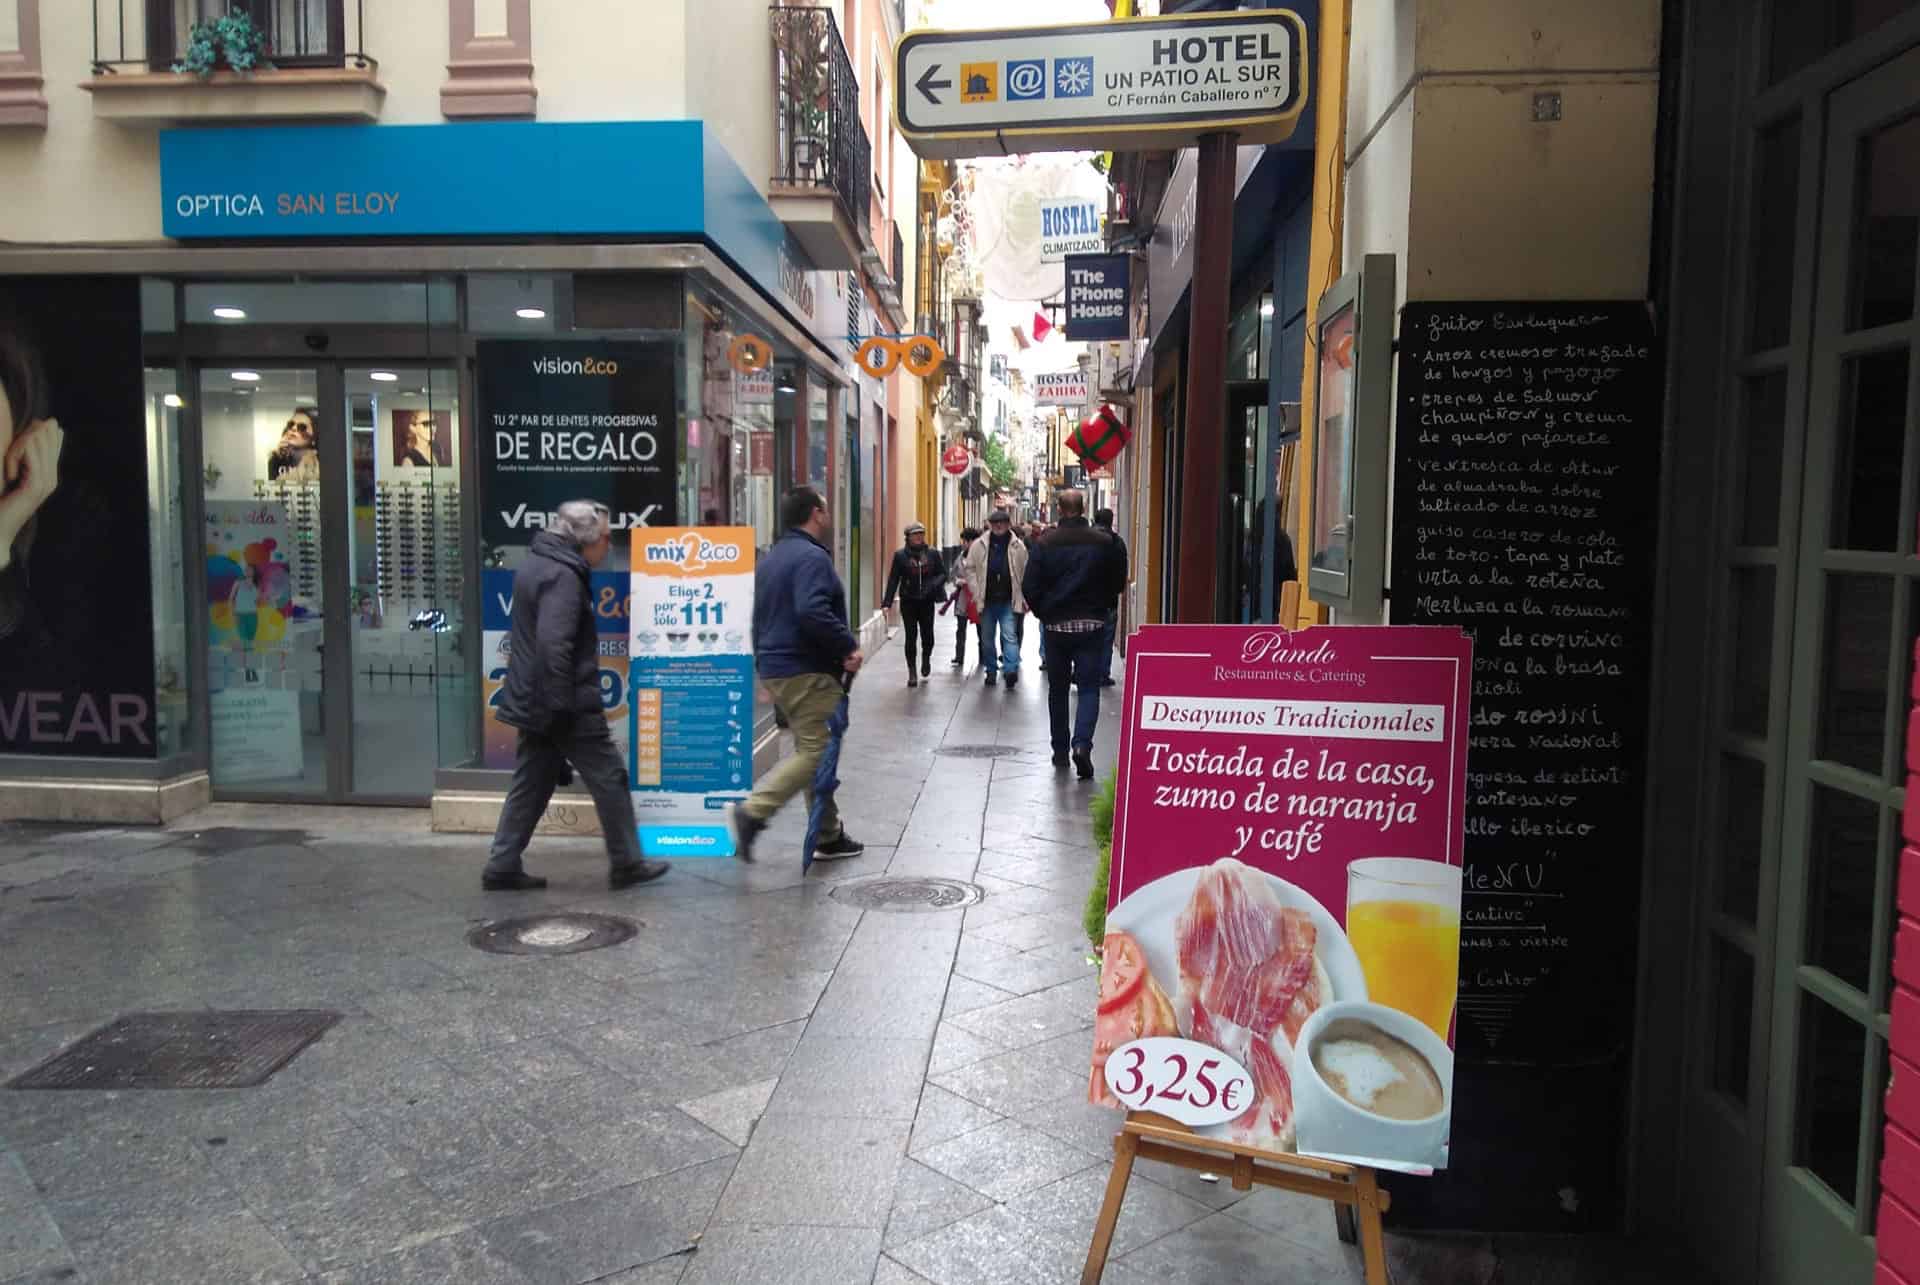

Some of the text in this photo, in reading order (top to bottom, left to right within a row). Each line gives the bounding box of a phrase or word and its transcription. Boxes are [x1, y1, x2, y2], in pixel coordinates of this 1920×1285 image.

[1153, 33, 1281, 65] HOTEL
[1105, 64, 1281, 89] UN PATIO AL SUR
[1107, 93, 1123, 107] C/
[1127, 90, 1176, 106] Fernán
[1181, 88, 1250, 104] Caballero
[1273, 86, 1281, 97] 7
[176, 192, 400, 217] OPTICA SAN ELOY
[1042, 204, 1098, 236] HOSTAL
[1042, 240, 1099, 254] CLIMATIZADO
[1071, 270, 1105, 284] The
[1071, 287, 1124, 301] Phone
[1071, 304, 1124, 318] House
[533, 357, 617, 374] vision&co
[1037, 373, 1087, 385] HOSTAL
[1423, 367, 1441, 380] de
[1521, 367, 1534, 383] y
[1494, 390, 1515, 403] de
[494, 415, 505, 426] TU
[521, 415, 539, 426] PAR
[542, 415, 554, 426] DE
[556, 415, 589, 426] LENTES
[592, 415, 657, 426] PROGRESIVAS
[1545, 411, 1556, 428] y
[1563, 411, 1633, 424] crema
[496, 432, 657, 461] DE REGALO
[1419, 429, 1440, 443] de
[1451, 432, 1512, 448] queso
[1528, 457, 1552, 473] de
[1417, 480, 1438, 493] de
[1506, 497, 1528, 513] de
[1550, 528, 1571, 544] de
[1416, 547, 1438, 561] de
[1558, 552, 1570, 570] y
[1468, 573, 1483, 585] a
[1488, 568, 1513, 585] la
[669, 582, 714, 601] Elige 2
[654, 602, 677, 616] por
[1504, 600, 1518, 614] a
[1522, 597, 1544, 615] la
[1499, 625, 1524, 647] de
[1241, 631, 1337, 664] Pando
[1503, 660, 1519, 674] a
[1525, 656, 1547, 674] la
[1214, 666, 1366, 686] Restaurantes & Catering
[1150, 703, 1435, 733] Desayunos Tradicionales
[1145, 743, 1435, 795] Tostada de la casa,
[1534, 768, 1553, 784] de
[1153, 782, 1417, 832] zumo de naranja
[1231, 821, 1324, 860] y café
[1115, 1047, 1244, 1112] 3,25€
